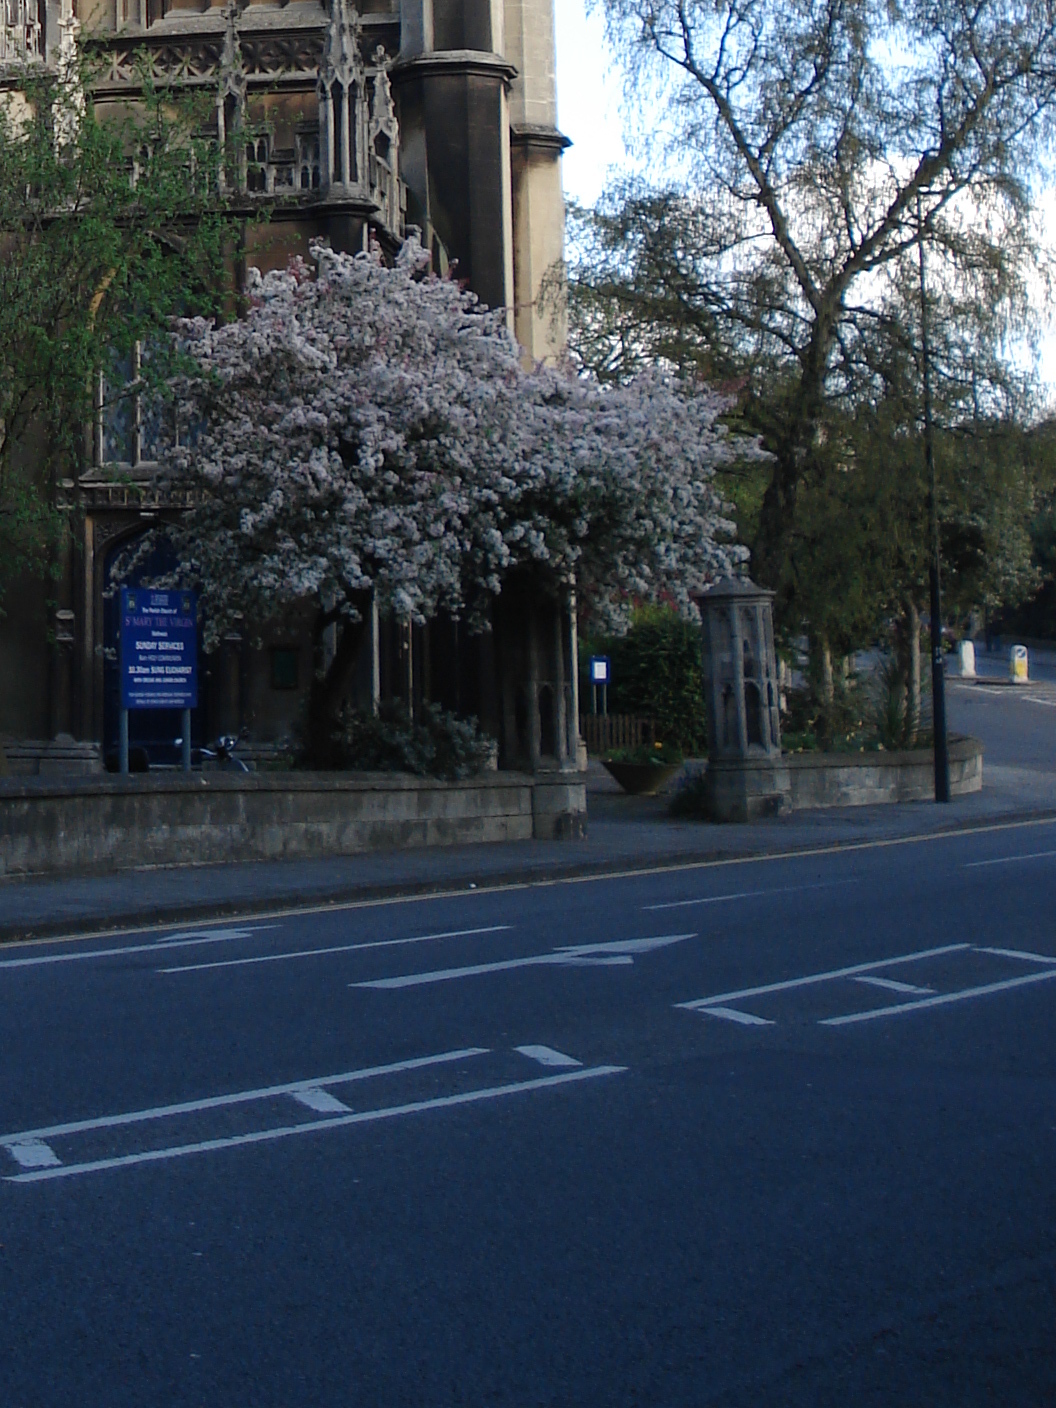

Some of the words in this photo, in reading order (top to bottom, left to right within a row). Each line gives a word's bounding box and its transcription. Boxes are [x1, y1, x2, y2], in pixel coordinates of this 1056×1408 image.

[133, 616, 152, 627] MARY
[156, 616, 168, 627] THE
[169, 616, 193, 628] VIRGIN
[135, 640, 157, 650] SUNDAY
[158, 641, 184, 651] SERVICES
[151, 666, 164, 674] SUNG
[165, 666, 192, 674] EUCHARIST
